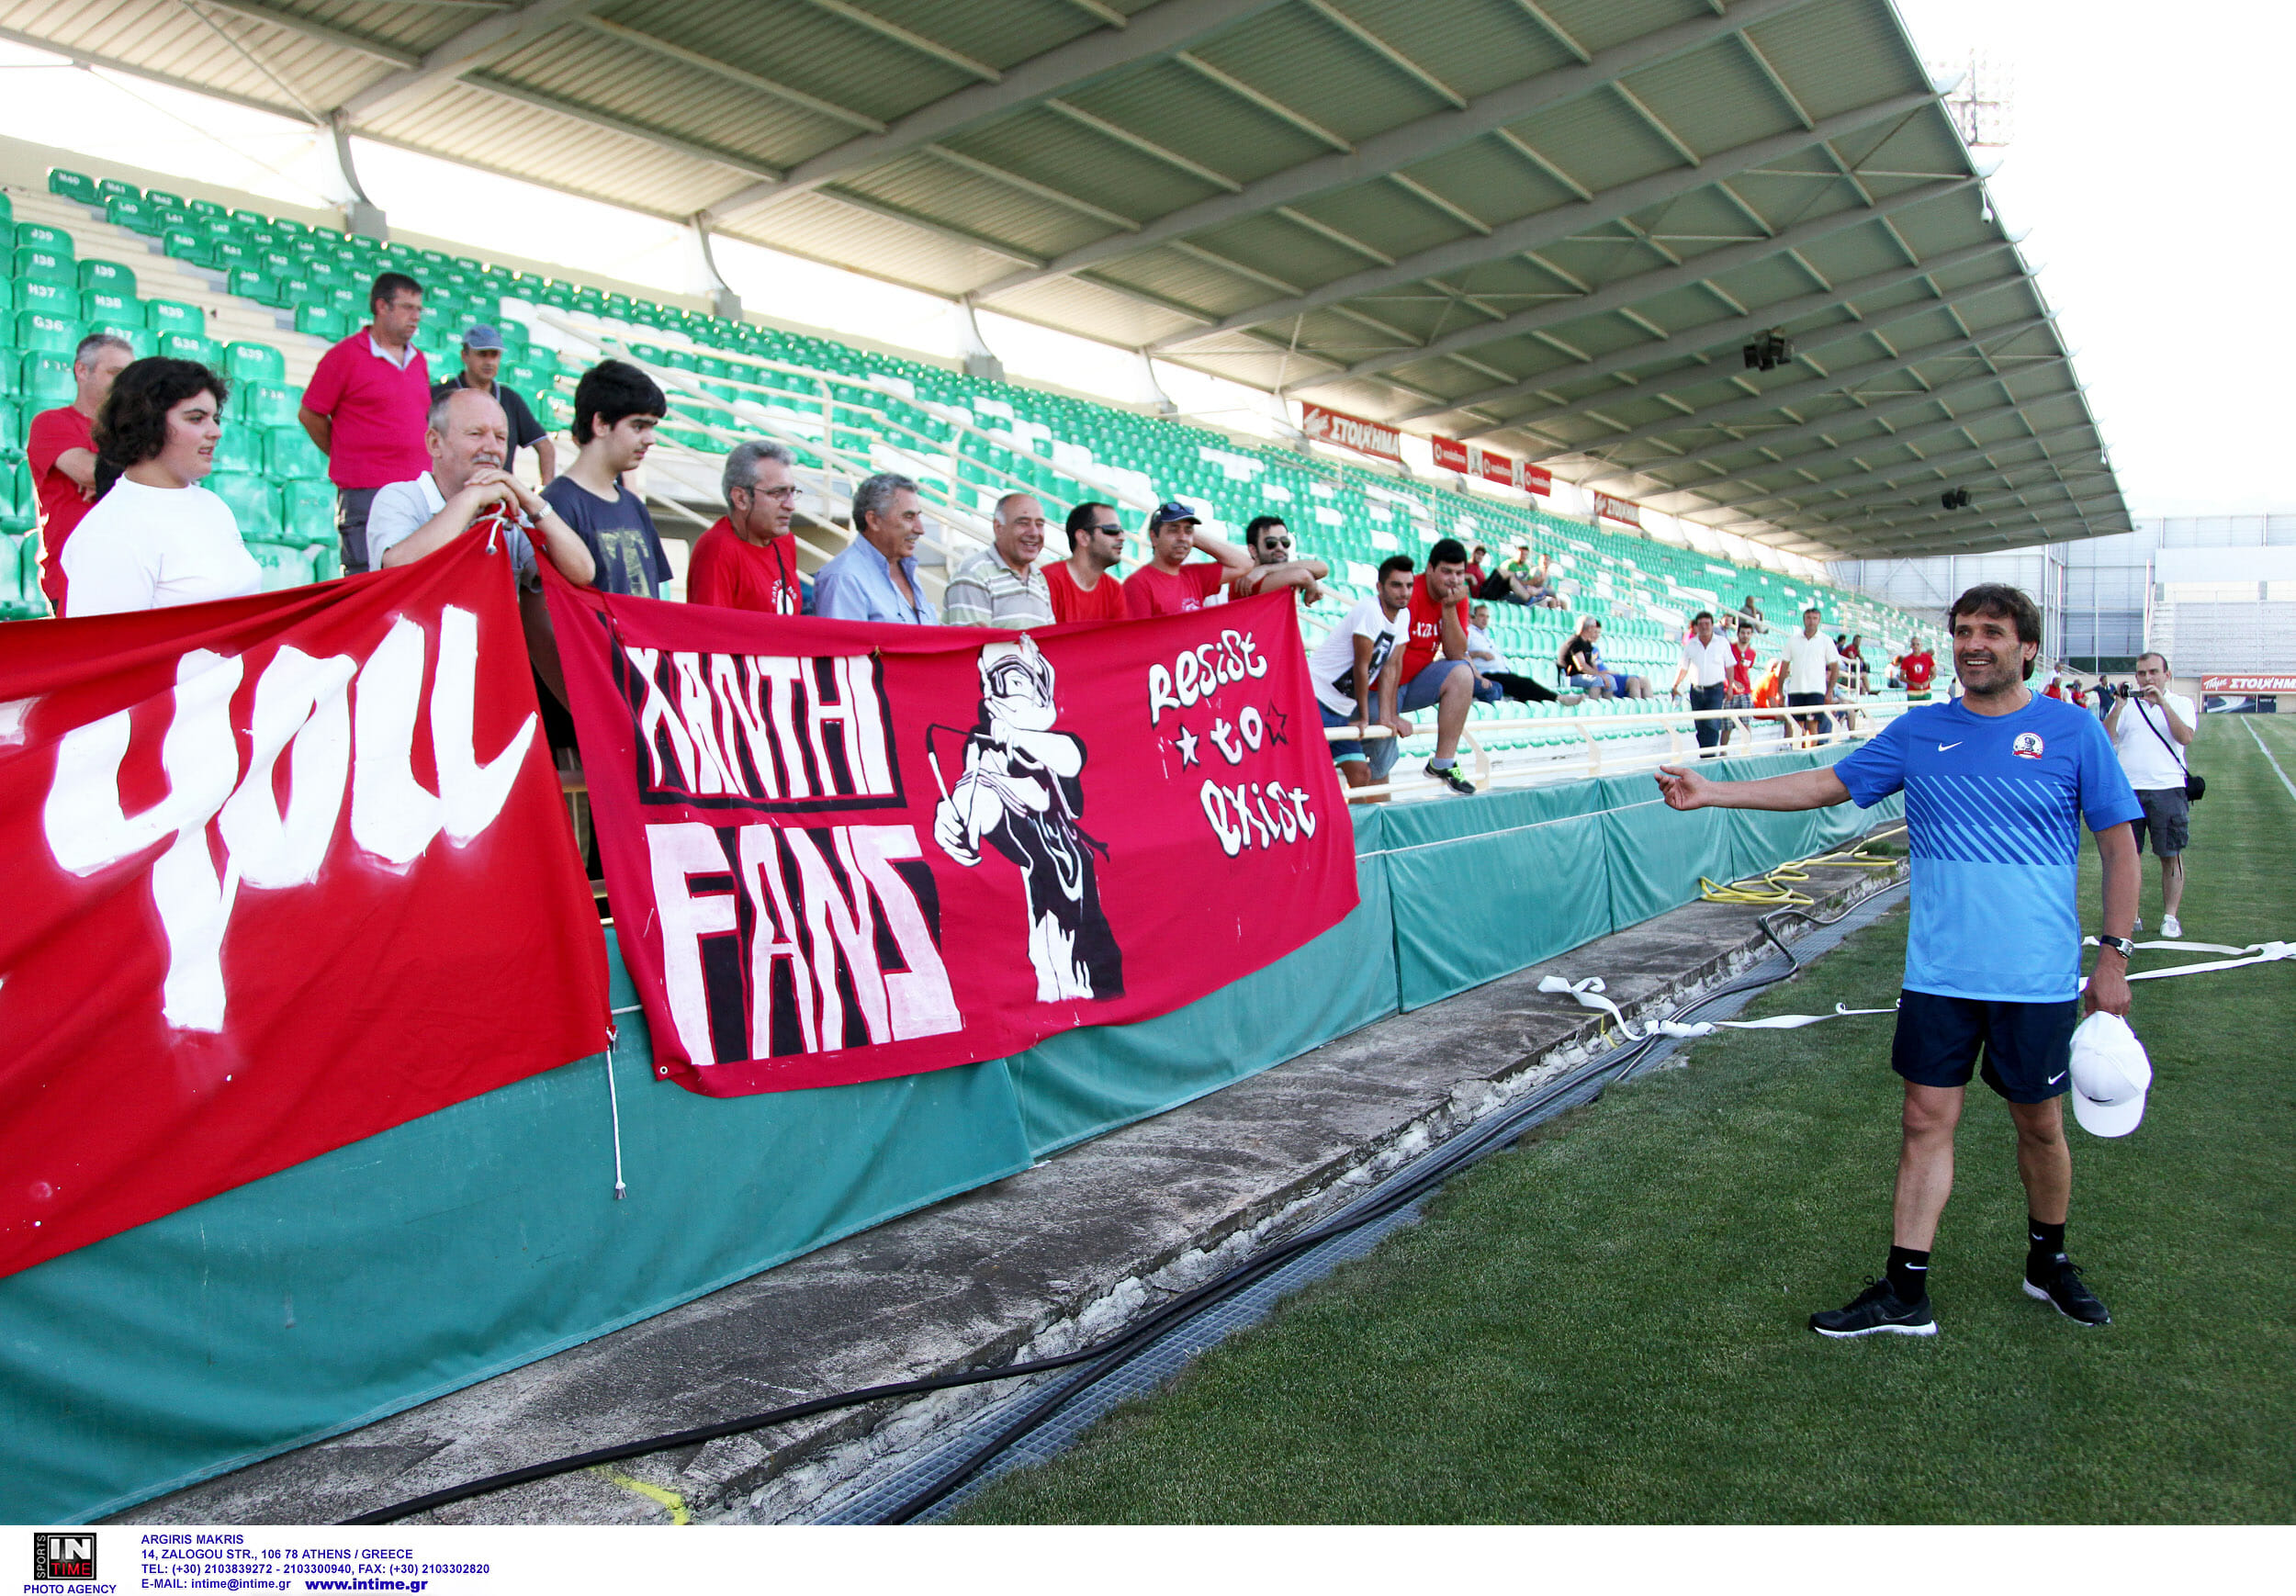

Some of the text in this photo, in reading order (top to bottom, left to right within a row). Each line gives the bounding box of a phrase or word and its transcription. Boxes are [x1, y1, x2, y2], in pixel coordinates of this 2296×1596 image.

[30, 229, 54, 242] J39
[28, 283, 55, 298] H37
[95, 294, 122, 309] H38
[158, 304, 184, 318] H39
[33, 315, 63, 332] G36
[172, 336, 199, 350] G38
[1330, 415, 1399, 455] ΣΤΟΙΧΗΜΑ
[625, 646, 895, 800] XANTHI
[1210, 705, 1264, 766] to
[645, 821, 963, 1066] FANS
